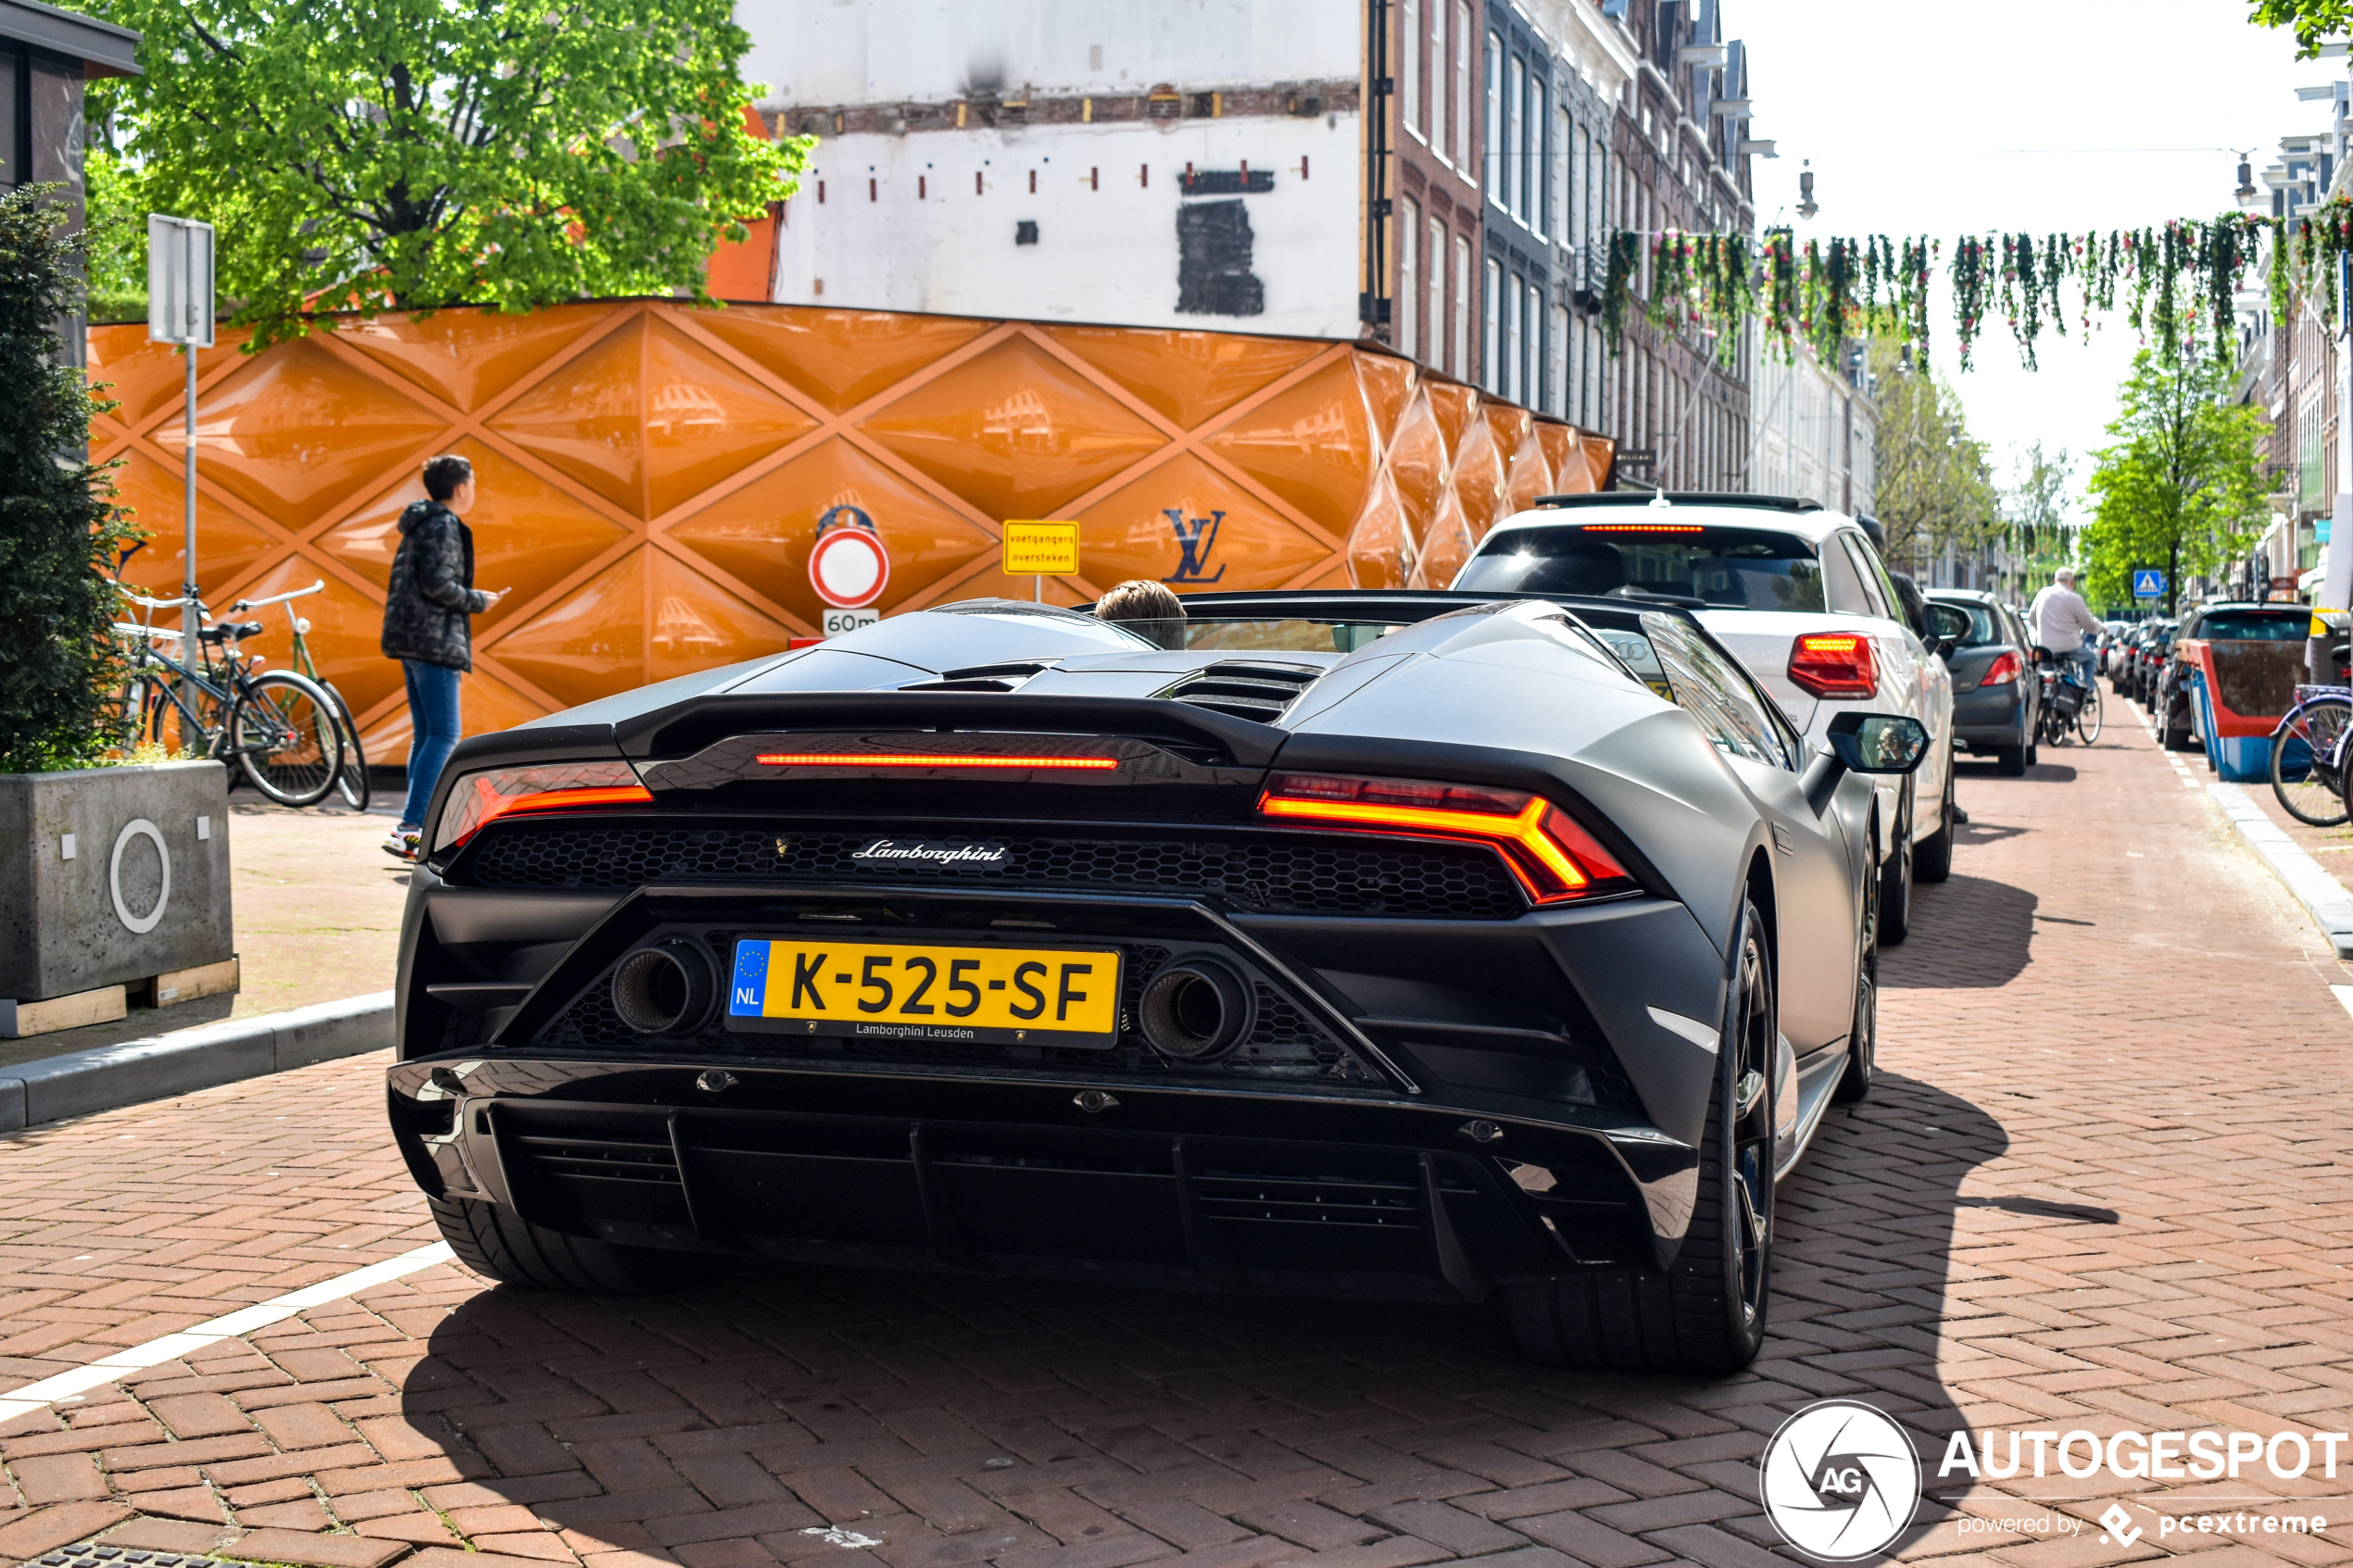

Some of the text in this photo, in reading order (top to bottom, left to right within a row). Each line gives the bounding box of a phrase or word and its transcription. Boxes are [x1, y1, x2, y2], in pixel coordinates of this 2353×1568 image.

[1009, 535, 1075, 546] voetgangers
[1013, 553, 1070, 562] oversteken
[851, 839, 1006, 865] Lamborghini
[791, 952, 1092, 1021] K-525-SF
[736, 987, 760, 1006] NL
[856, 1022, 974, 1039] Lamborghini Leusden
